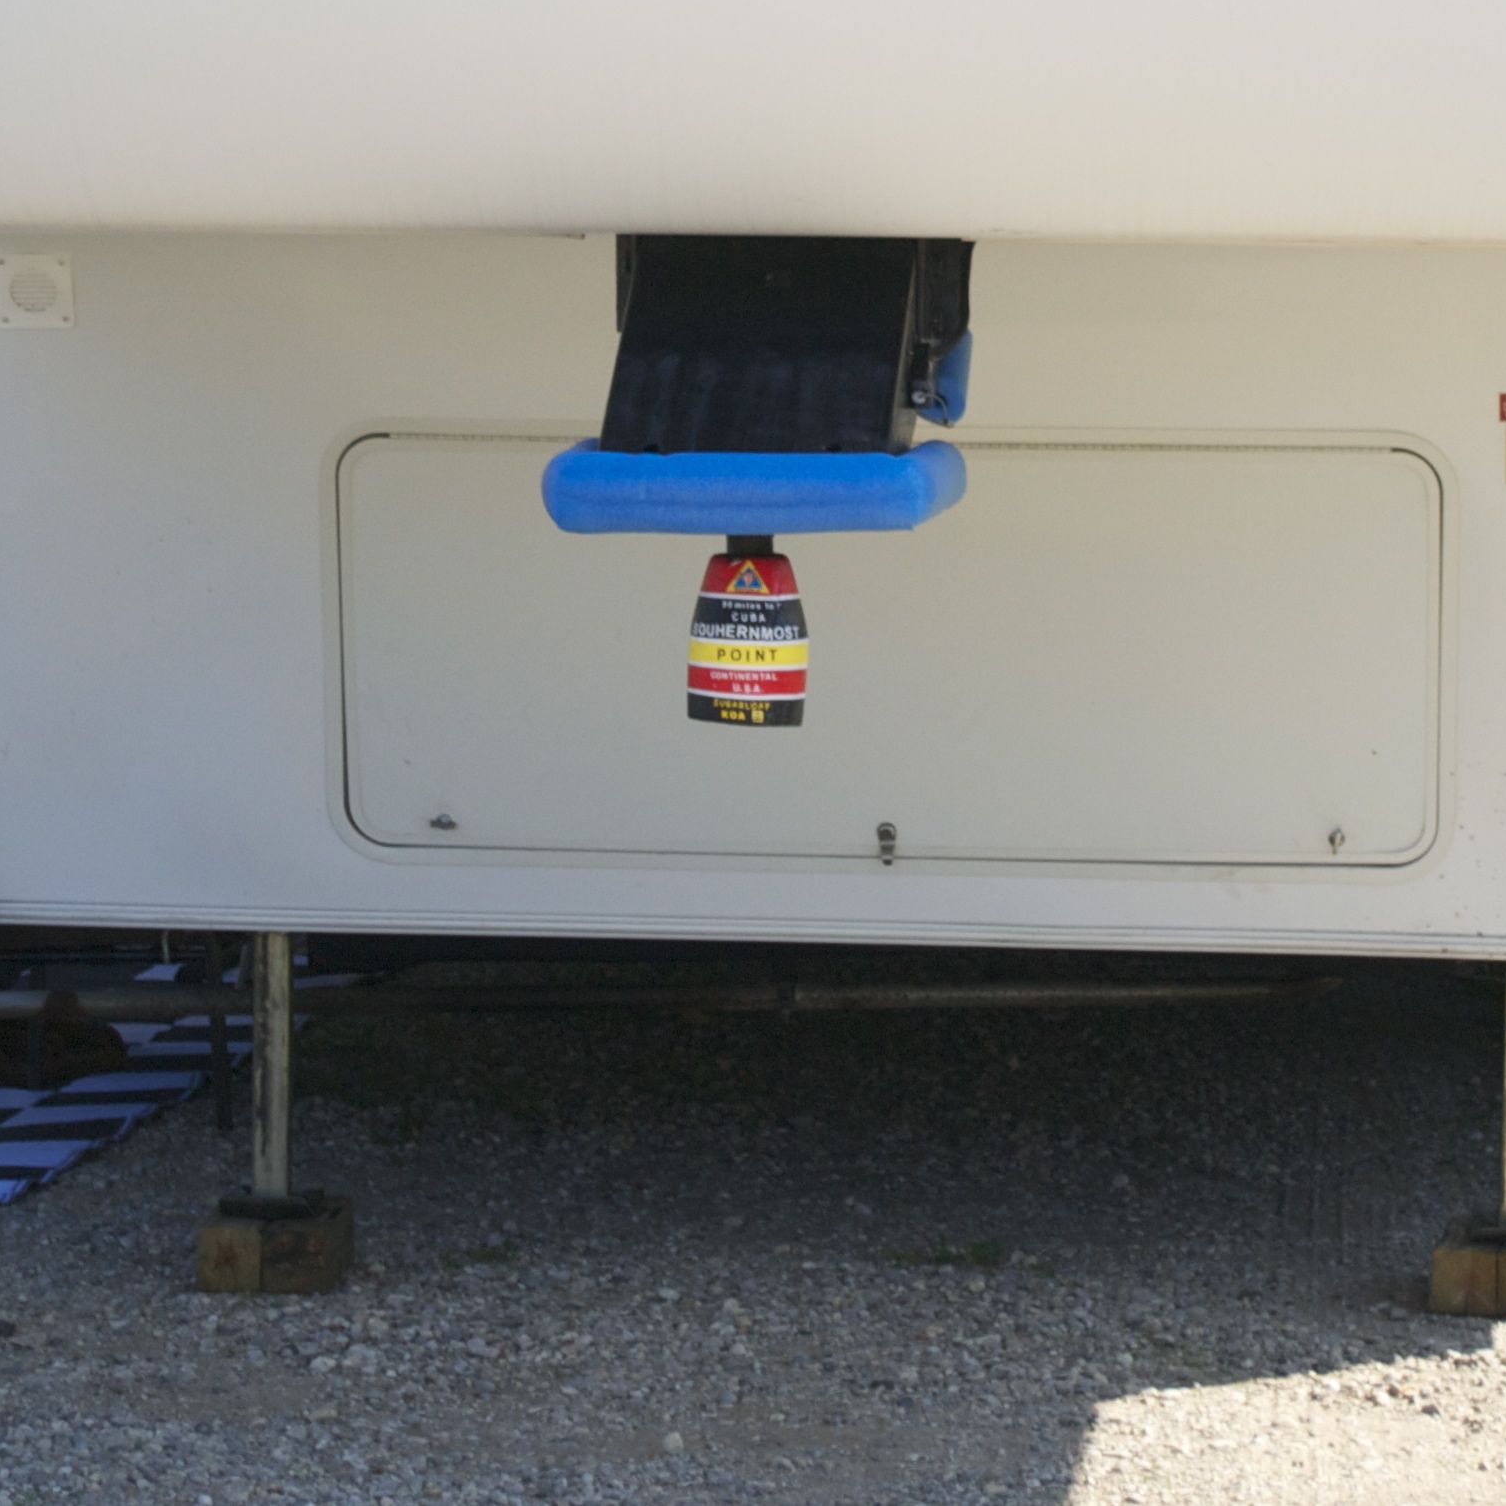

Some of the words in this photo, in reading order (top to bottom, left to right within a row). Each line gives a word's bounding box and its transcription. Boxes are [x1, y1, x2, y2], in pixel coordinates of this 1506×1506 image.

[731, 611, 767, 623] CUBA
[717, 648, 779, 662] POINT
[710, 670, 778, 682] CONTINENTAL
